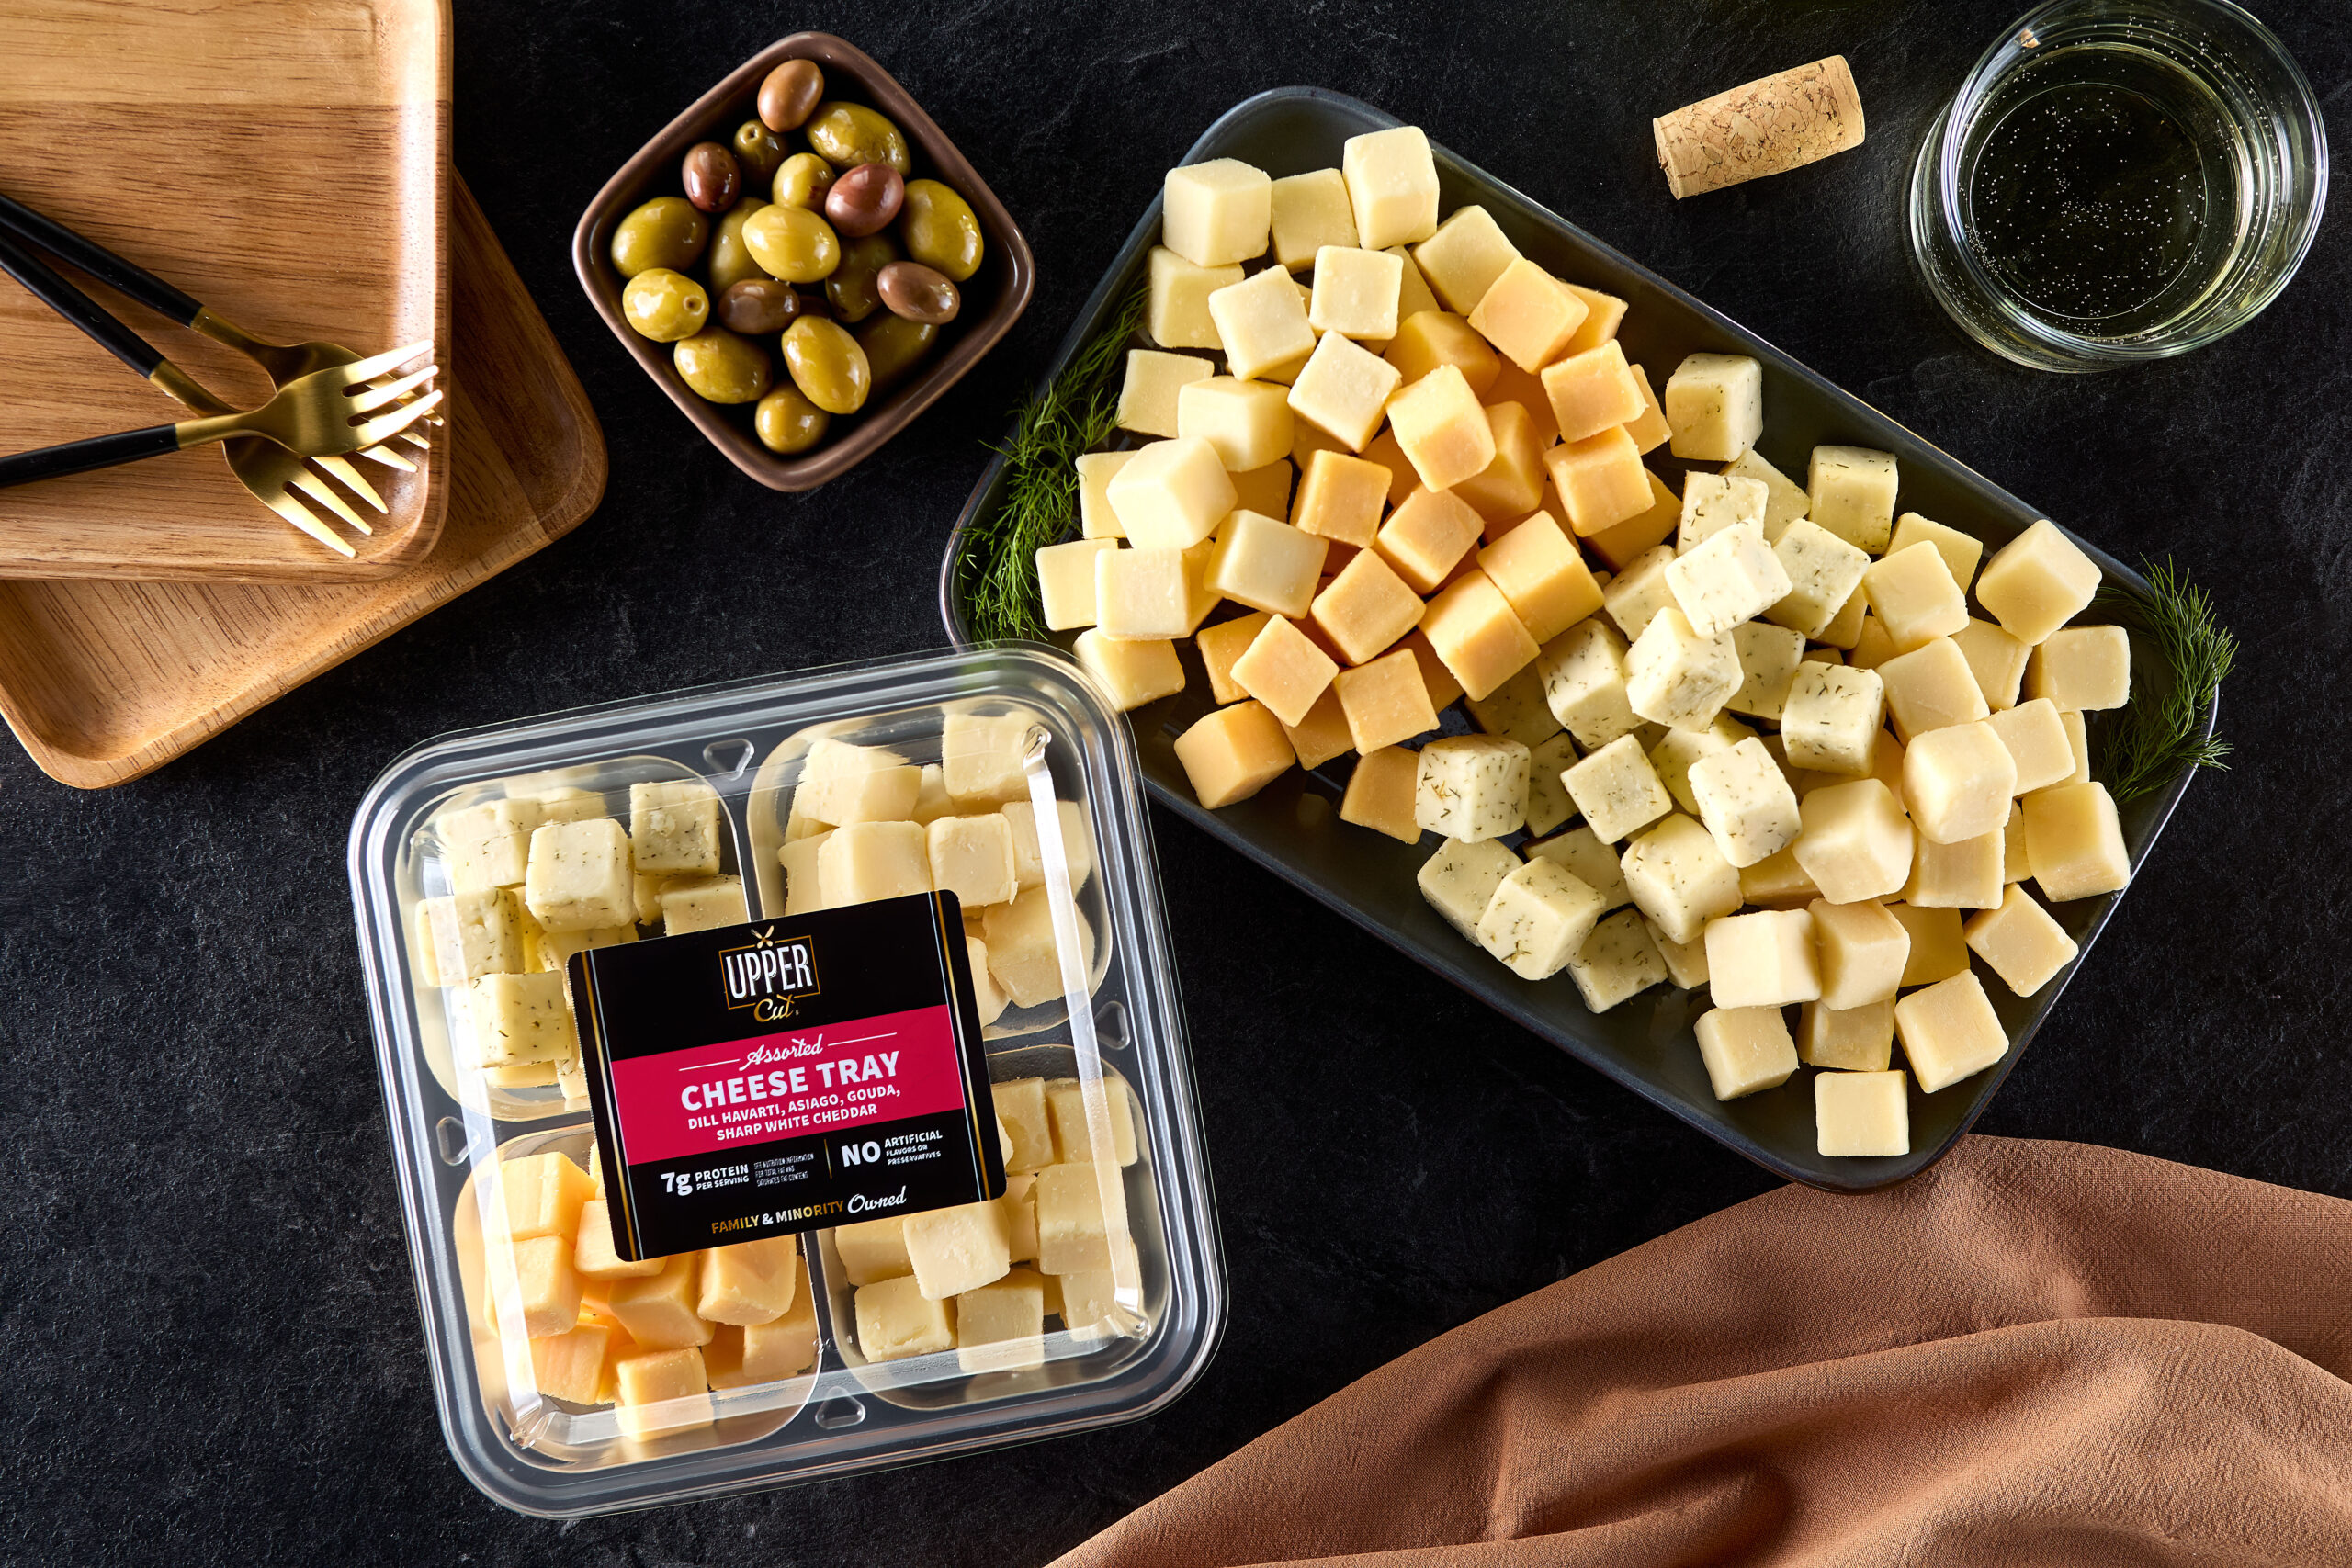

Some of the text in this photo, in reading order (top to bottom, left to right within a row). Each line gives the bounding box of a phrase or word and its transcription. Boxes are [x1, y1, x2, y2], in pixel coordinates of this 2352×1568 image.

[726, 943, 813, 999] UPPER
[753, 994, 794, 1023] Cut
[739, 1033, 823, 1071] Assorted
[681, 1051, 899, 1111] CHEESE TRAY
[688, 1084, 901, 1131] DILL HAVARTI, ASIAGO, GOUDA,
[717, 1103, 878, 1141] SHARP WHITE CHEDDAR
[884, 1130, 943, 1148] ARTIFICIAL
[886, 1144, 928, 1157] FLAVORS OR
[841, 1140, 881, 1168] NO
[887, 1150, 942, 1166] PRESERVATIVES
[661, 1171, 693, 1196] 7g
[695, 1163, 750, 1182] PROTEIN
[696, 1175, 750, 1191] PER SERVING
[711, 1185, 907, 1235] FAMILY & MINORITY Owned
